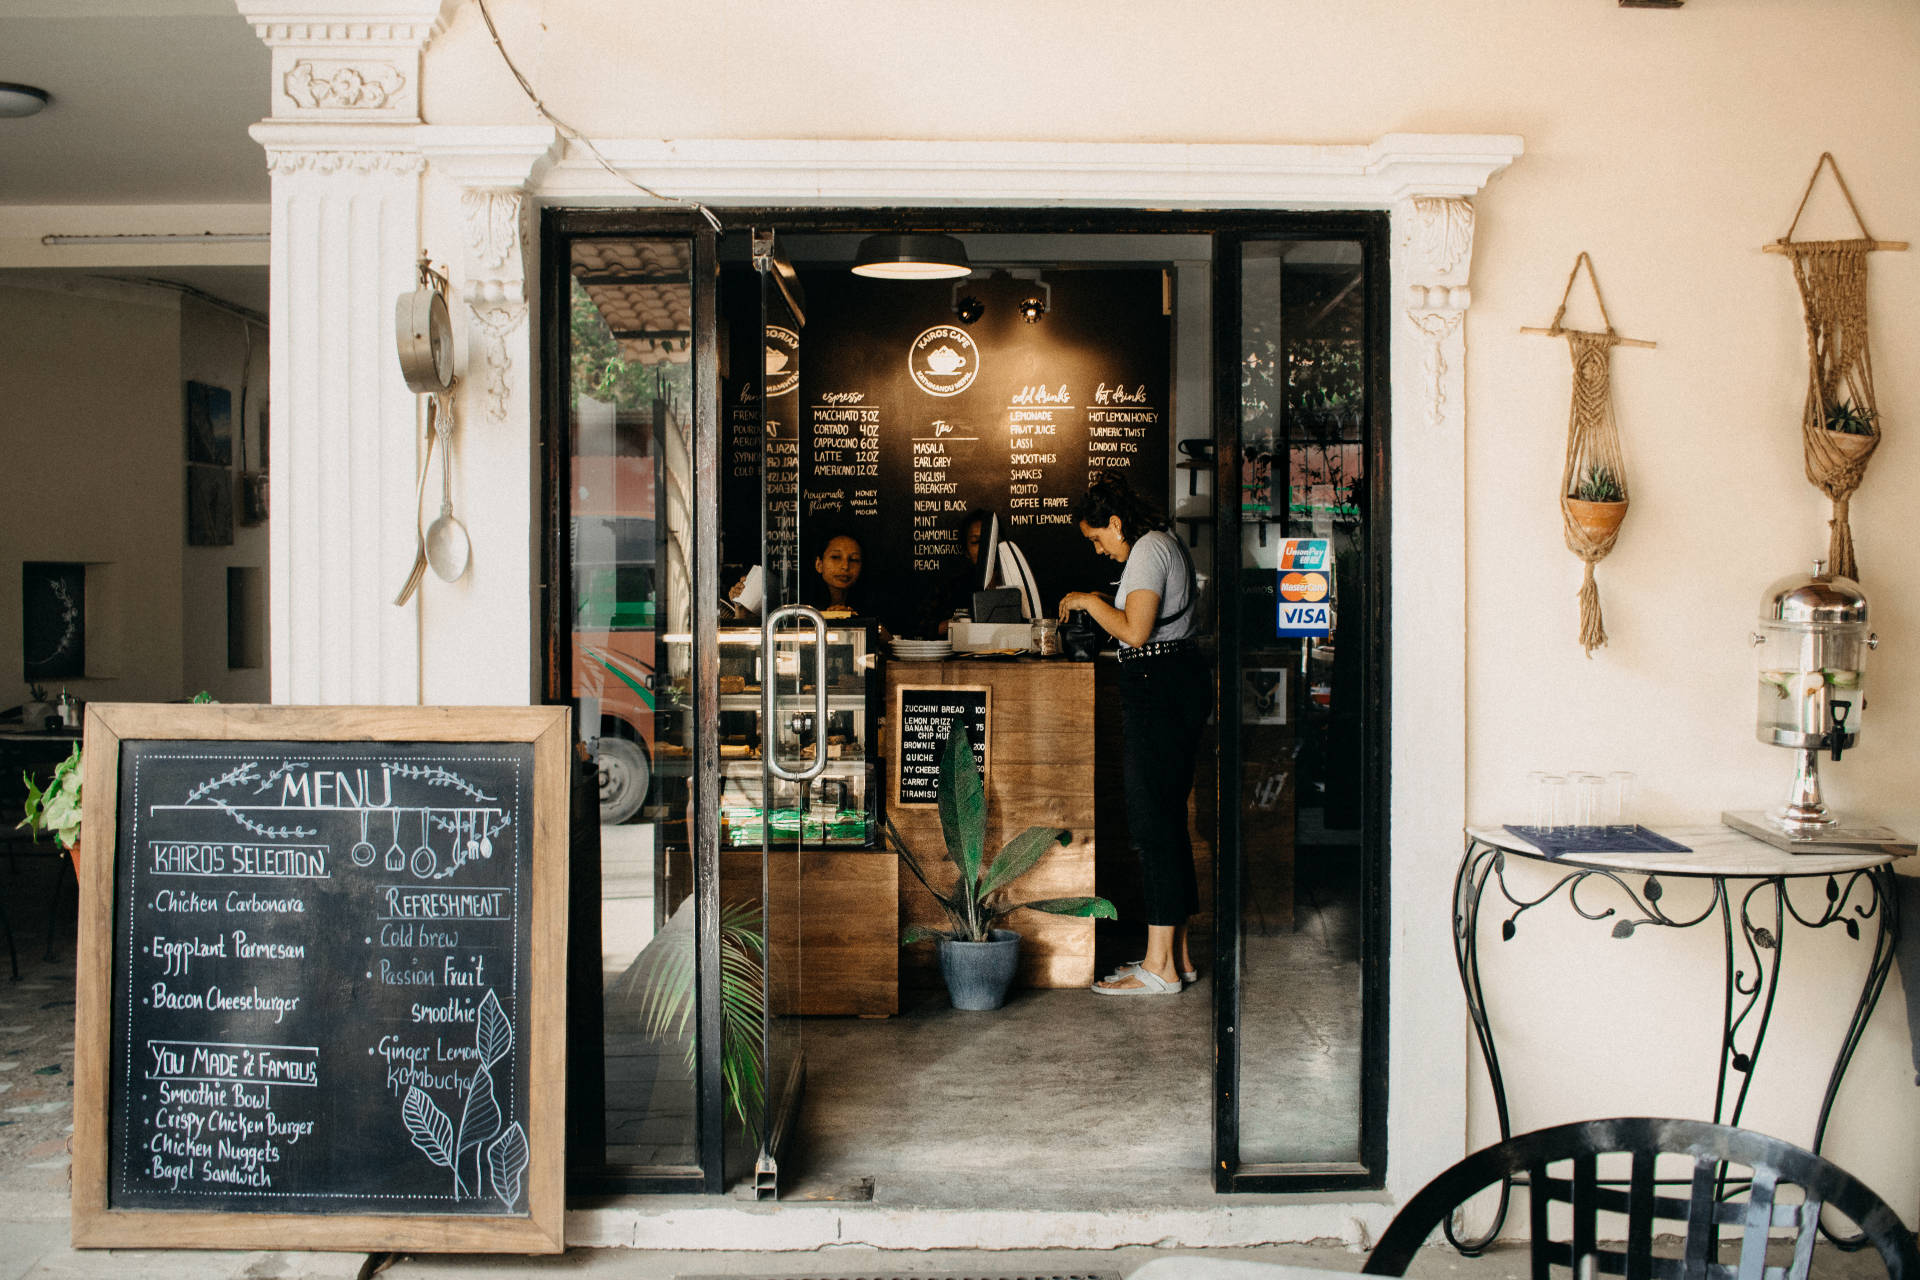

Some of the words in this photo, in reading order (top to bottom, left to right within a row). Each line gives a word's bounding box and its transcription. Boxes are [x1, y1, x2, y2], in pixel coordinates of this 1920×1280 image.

[917, 329, 948, 349] KAIROS
[949, 330, 971, 348] CAFE
[916, 370, 955, 392] KATHMANDU
[953, 371, 973, 390] NEPAL
[1012, 385, 1036, 405] cold
[1035, 384, 1071, 404] drinks
[1095, 382, 1113, 405] hot
[1112, 384, 1147, 403] drinks
[822, 391, 865, 408] espresso
[814, 410, 859, 421] MACCHIATO
[1010, 411, 1053, 422] LEMONADE
[1088, 412, 1105, 422] HOT
[1105, 412, 1131, 423] LEMON
[1131, 412, 1159, 423] HONEY
[814, 424, 849, 435] CORTADO
[931, 420, 953, 437] Tea
[1010, 425, 1033, 435] FRUIT
[1034, 425, 1056, 435] JUICE
[1089, 427, 1122, 437] TURMERIC
[1124, 427, 1146, 438] TWIST
[814, 438, 858, 449] CAPPUCCINO
[913, 443, 944, 454] MASALA
[1010, 438, 1033, 449] LASSI
[1089, 441, 1117, 452] LONDON
[1120, 442, 1138, 453] FOG
[814, 451, 843, 462] LATTE
[914, 456, 932, 467] EARL
[933, 456, 952, 468] GREY
[1011, 453, 1057, 465] SMOOTHIES
[1088, 456, 1105, 467] HOT
[1106, 457, 1131, 467] COCOA
[734, 466, 754, 477] COLD
[814, 465, 856, 476] AMERICANO
[1010, 469, 1043, 480] SHAKES
[914, 471, 945, 482] ENGLISH
[855, 489, 878, 497] HONEY
[914, 482, 958, 494] BREAKFAST
[1010, 484, 1038, 494] MOJITO
[914, 500, 941, 511] NEPALI
[944, 500, 967, 511] BLACK
[1010, 498, 1040, 509] COFFEE
[1043, 497, 1069, 508] FRAPPE
[855, 508, 878, 516] MOCHA
[914, 515, 938, 527] MINT
[1011, 514, 1035, 525] MINT
[1036, 514, 1073, 525] LEMONADE
[913, 529, 959, 541] CHAMOMILE
[1285, 547, 1324, 558] UnionPay
[914, 559, 940, 571] PEACH
[1281, 583, 1326, 592] MasterCard
[1282, 608, 1327, 624] VISA
[904, 705, 939, 713] ZUCCHINI
[941, 705, 965, 714] BREAD
[975, 706, 986, 714] 100
[904, 717, 928, 725] LEMON
[975, 723, 985, 732] 75
[917, 732, 934, 740] CHIP
[903, 741, 936, 750] BROWNIE
[973, 743, 985, 751] 200
[905, 753, 934, 762] QUICHE
[915, 766, 940, 775] CHEESE
[902, 778, 929, 786] CARROT
[281, 768, 392, 808] MENU
[901, 790, 937, 798] TIRAMISU
[155, 845, 225, 874] KAIROS
[232, 845, 325, 876] SELECTION
[155, 889, 218, 913] Chicken
[225, 890, 306, 913] Carbonara
[385, 887, 503, 918] REFRESHMENT
[380, 923, 413, 947] Cold
[419, 923, 459, 948] brew
[152, 933, 227, 977] Eggplant
[232, 929, 305, 960] Parmesan
[380, 957, 435, 986] Passion
[444, 954, 485, 986] Fruit
[152, 981, 204, 1009] Bacon
[206, 985, 300, 1024] Cheeseburger
[378, 1035, 430, 1076] Ginger
[437, 1037, 479, 1061] Lemon
[152, 1045, 185, 1077] YOU
[191, 1047, 239, 1077] MADE
[259, 1052, 317, 1082] FAMOUS
[387, 1065, 473, 1099] Kombucha
[159, 1081, 227, 1107] Smoothie
[232, 1082, 271, 1110] Bowl
[155, 1105, 205, 1140] Crispy
[208, 1110, 264, 1141] Chicken
[266, 1112, 315, 1144] Burger
[151, 1132, 212, 1158] Chicken
[218, 1137, 280, 1170] Nuggets
[152, 1155, 194, 1191] Bagel
[202, 1160, 272, 1187] Sandwich
